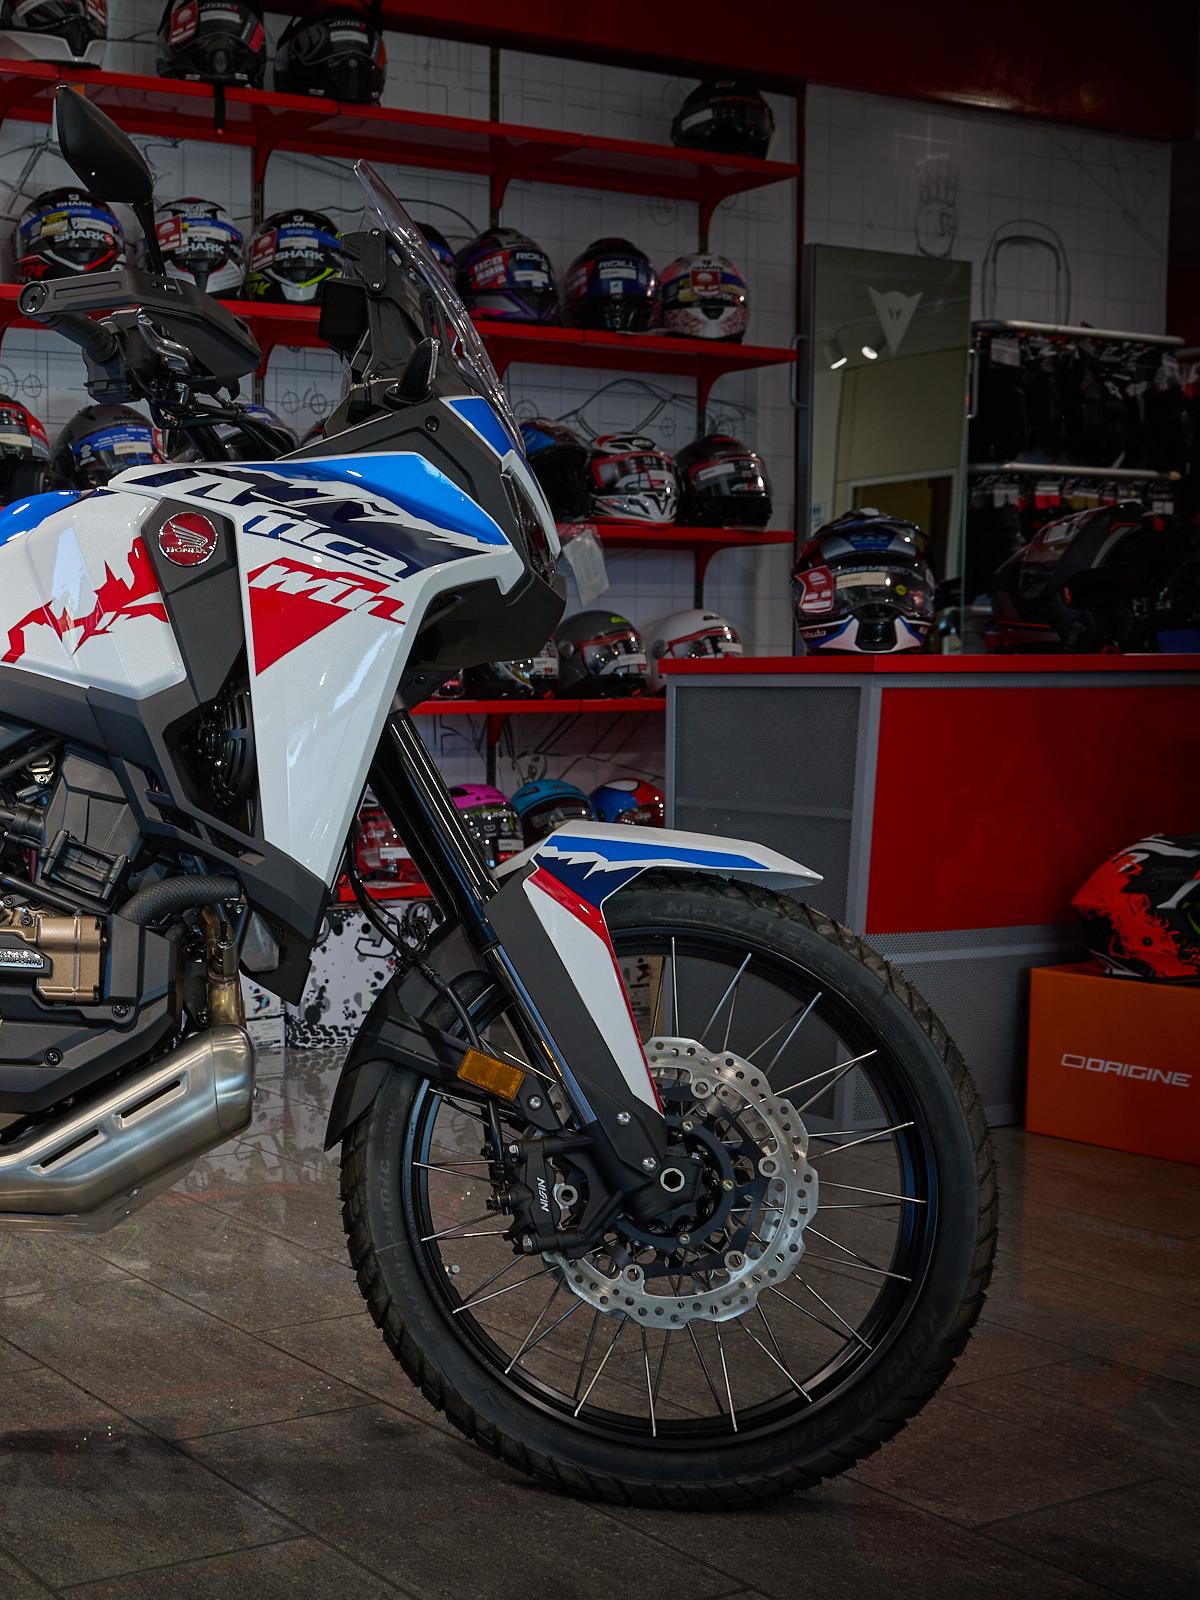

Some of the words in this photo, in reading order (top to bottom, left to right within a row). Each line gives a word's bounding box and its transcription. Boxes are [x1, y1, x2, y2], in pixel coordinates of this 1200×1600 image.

[56, 200, 92, 208] SHARK
[280, 221, 316, 229] SHARK
[53, 229, 105, 242] SHARK
[174, 242, 225, 254] SHARK
[274, 250, 324, 262] SHARK
[536, 1177, 550, 1213] NISSIN
